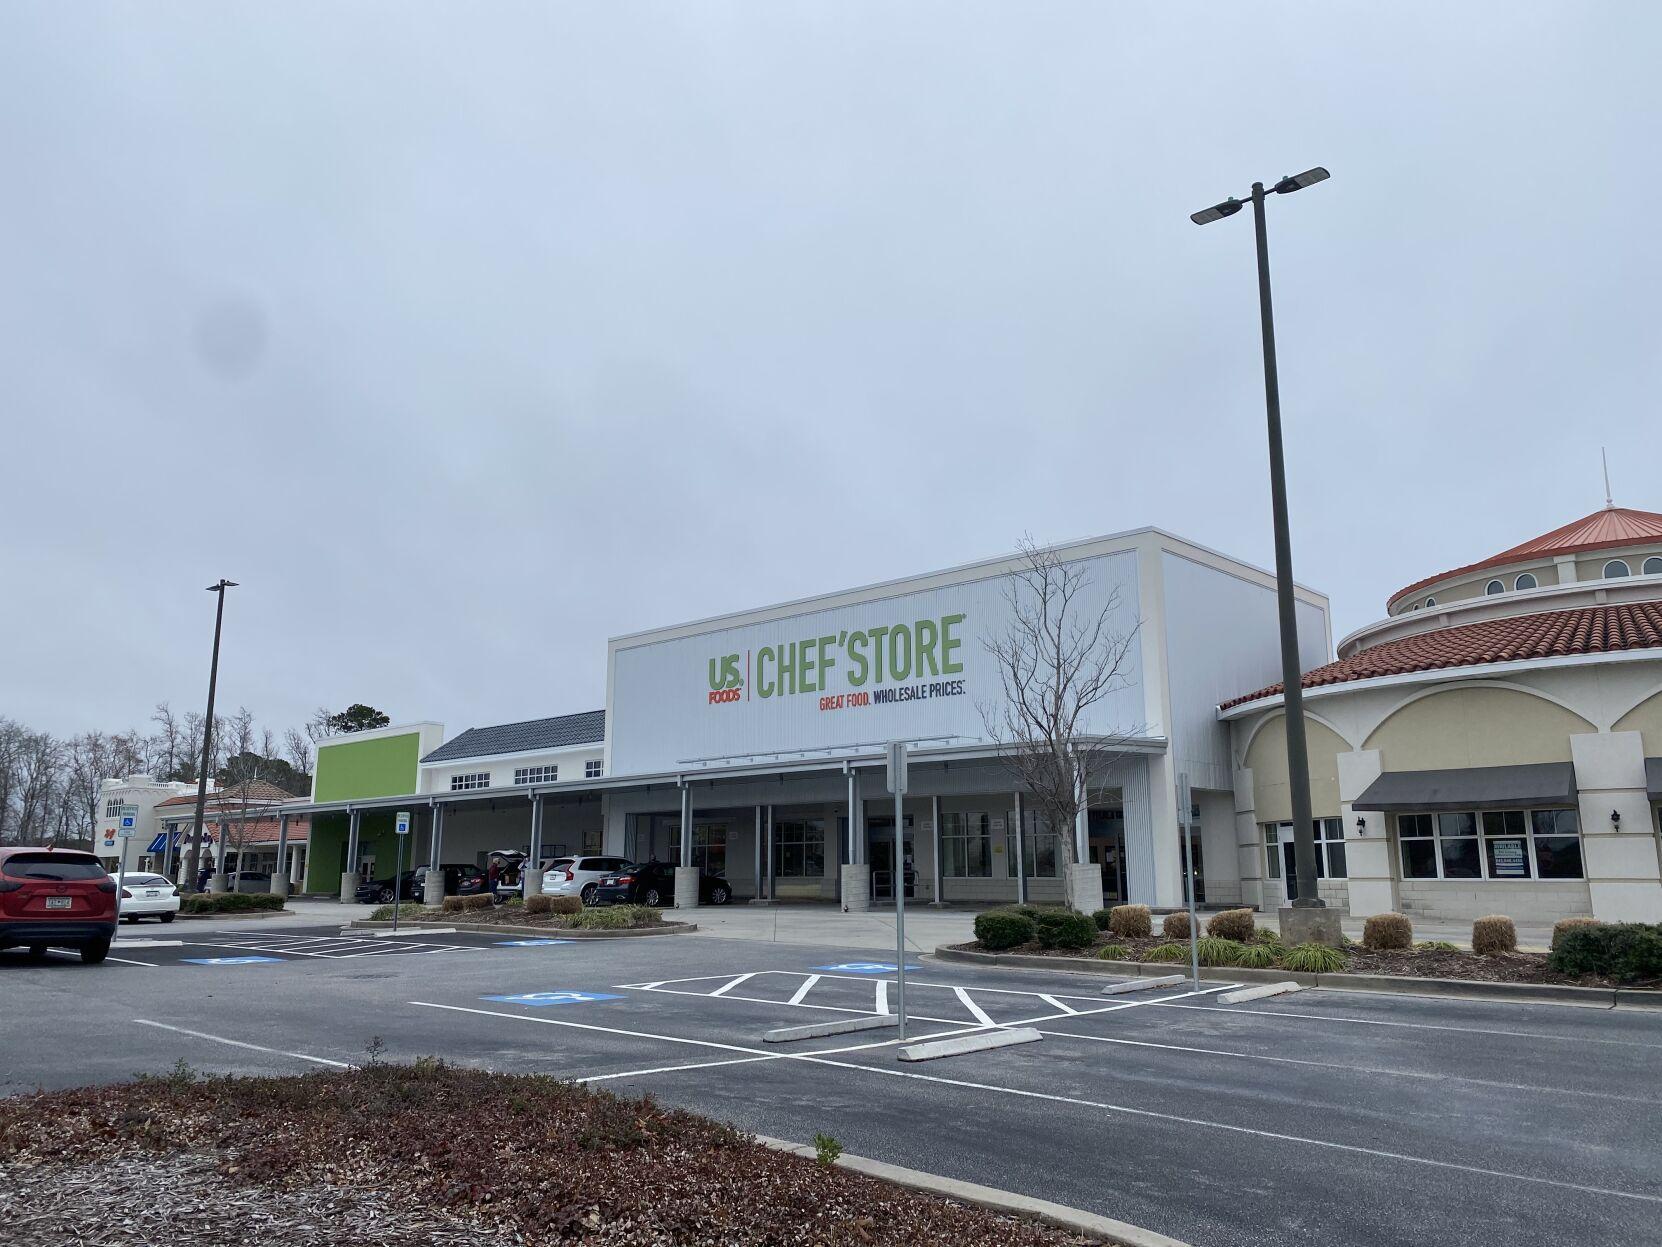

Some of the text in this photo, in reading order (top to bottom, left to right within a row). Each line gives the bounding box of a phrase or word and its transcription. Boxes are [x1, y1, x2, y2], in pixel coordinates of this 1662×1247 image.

[757, 613, 963, 698] CHEF'STORE
[709, 688, 741, 704] FOODS
[819, 694, 845, 711] GREAT
[846, 691, 871, 708] FOOD.
[873, 684, 928, 705] WHOLESALE
